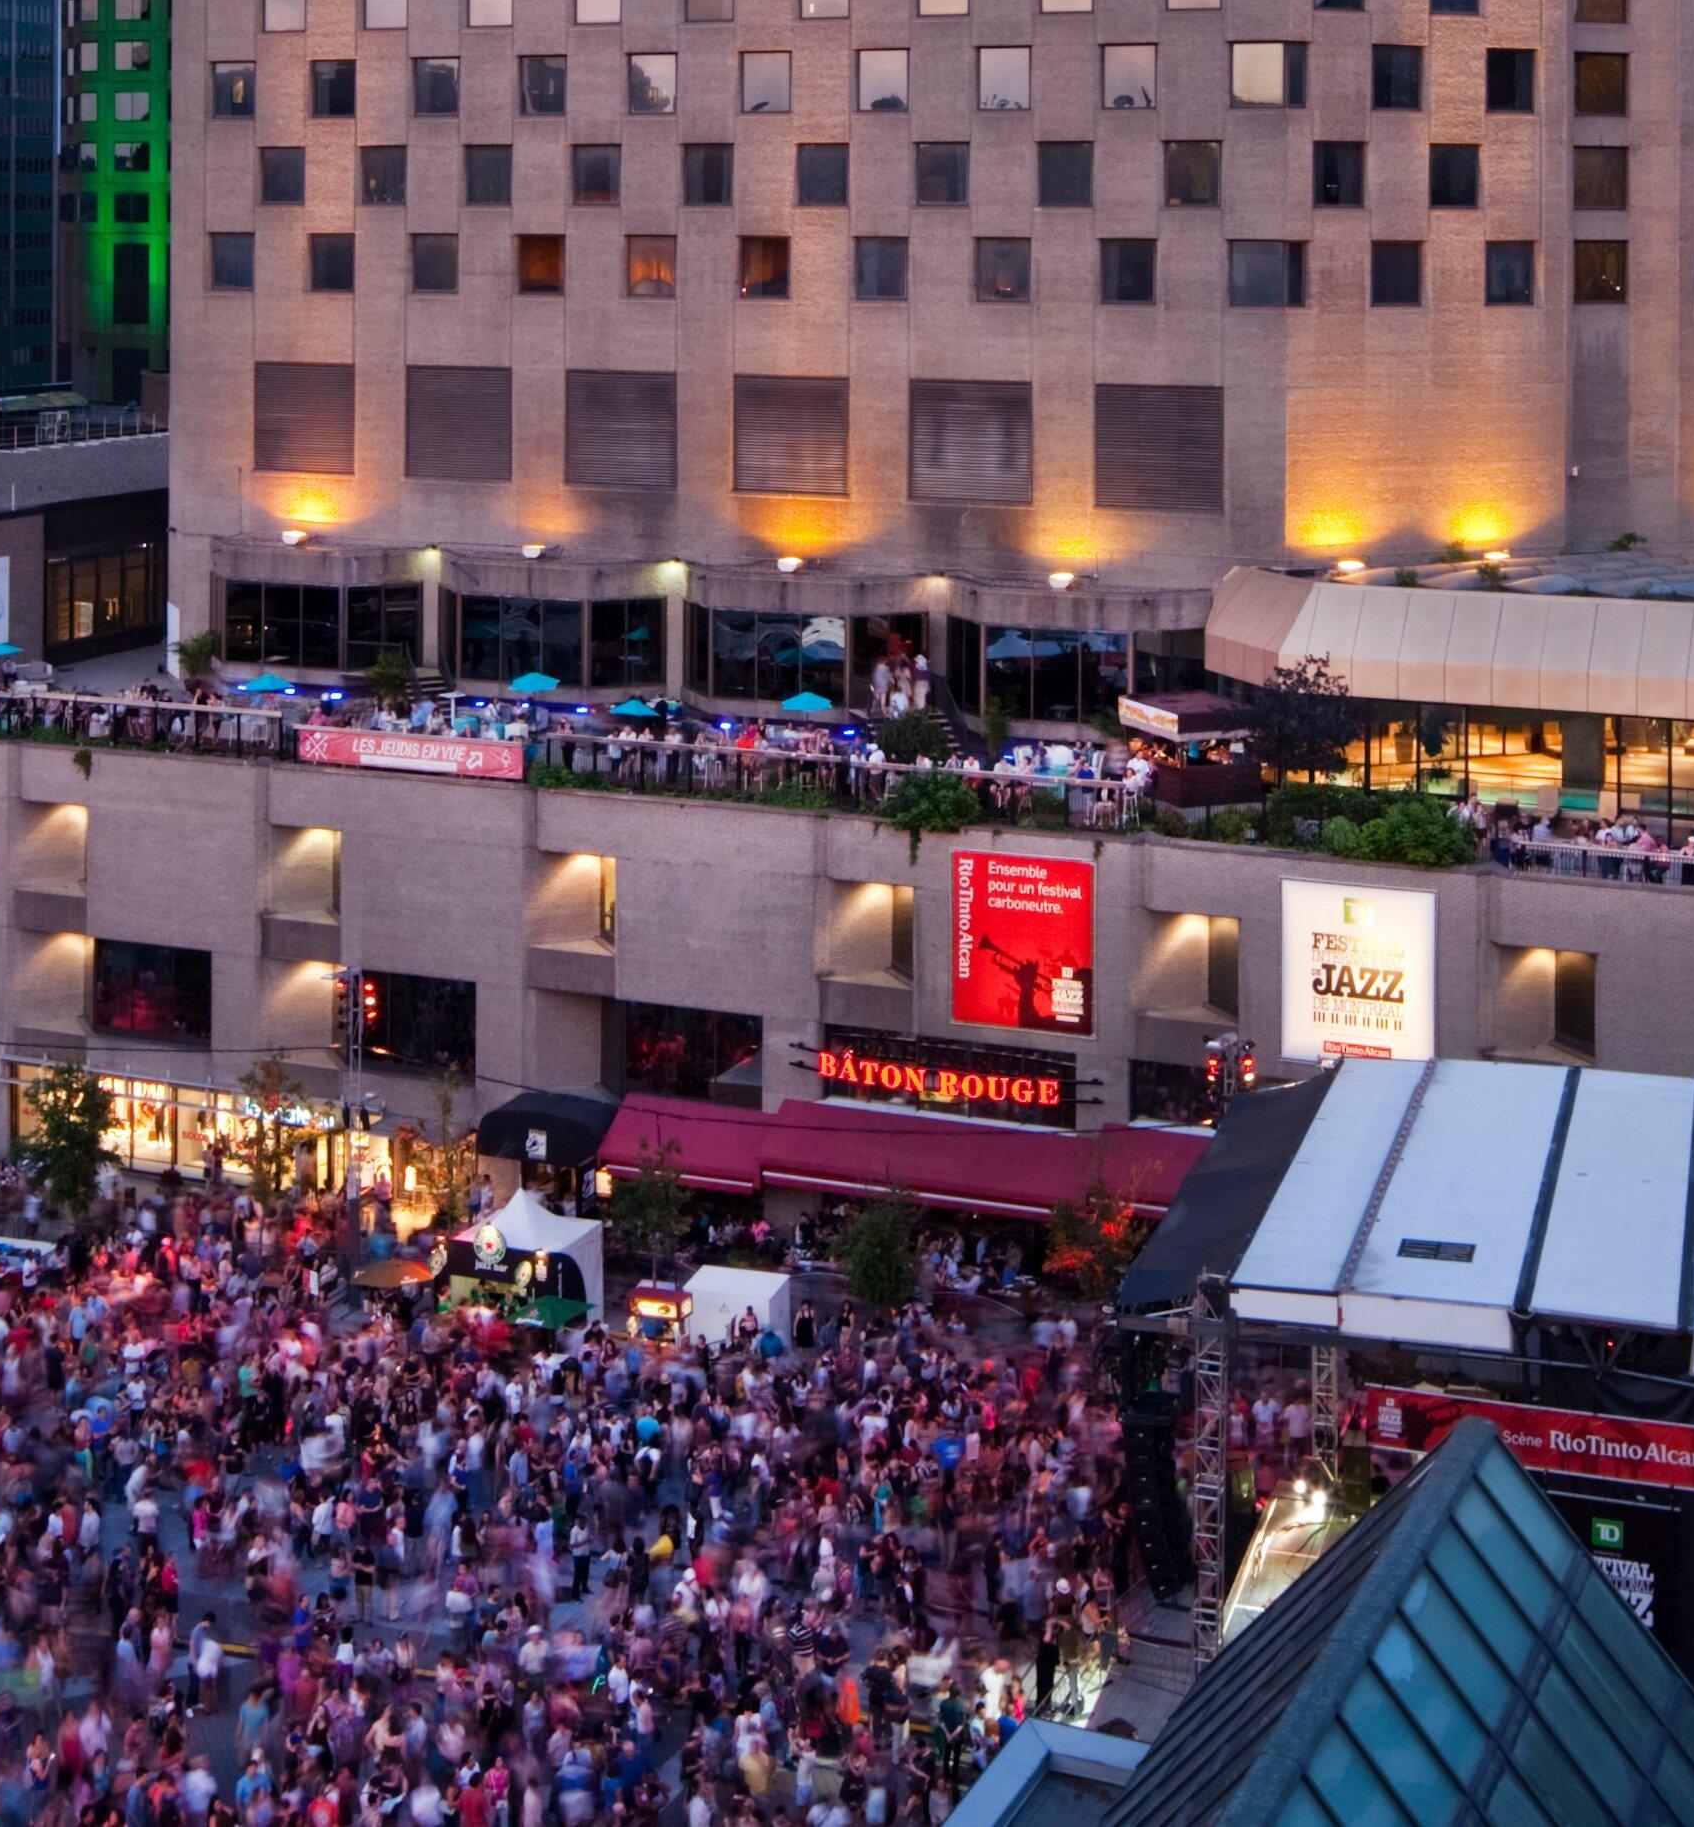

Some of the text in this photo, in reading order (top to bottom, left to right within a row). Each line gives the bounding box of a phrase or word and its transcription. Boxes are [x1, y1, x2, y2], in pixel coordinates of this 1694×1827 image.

[352, 737, 466, 762] LES JEUDIS EN VUE
[988, 861, 1047, 879] Ensemble
[988, 880, 1082, 899] pour un festival
[987, 896, 1063, 914] carboneutre.
[1312, 963, 1404, 1003] JAZZ
[1312, 996, 1329, 1010] DE
[818, 1049, 1060, 1105] BÂTON ROUGE
[1502, 1430, 1543, 1448] Scène
[1594, 1521, 1622, 1544] TD
[1595, 1556, 1654, 1582] TIVAL
